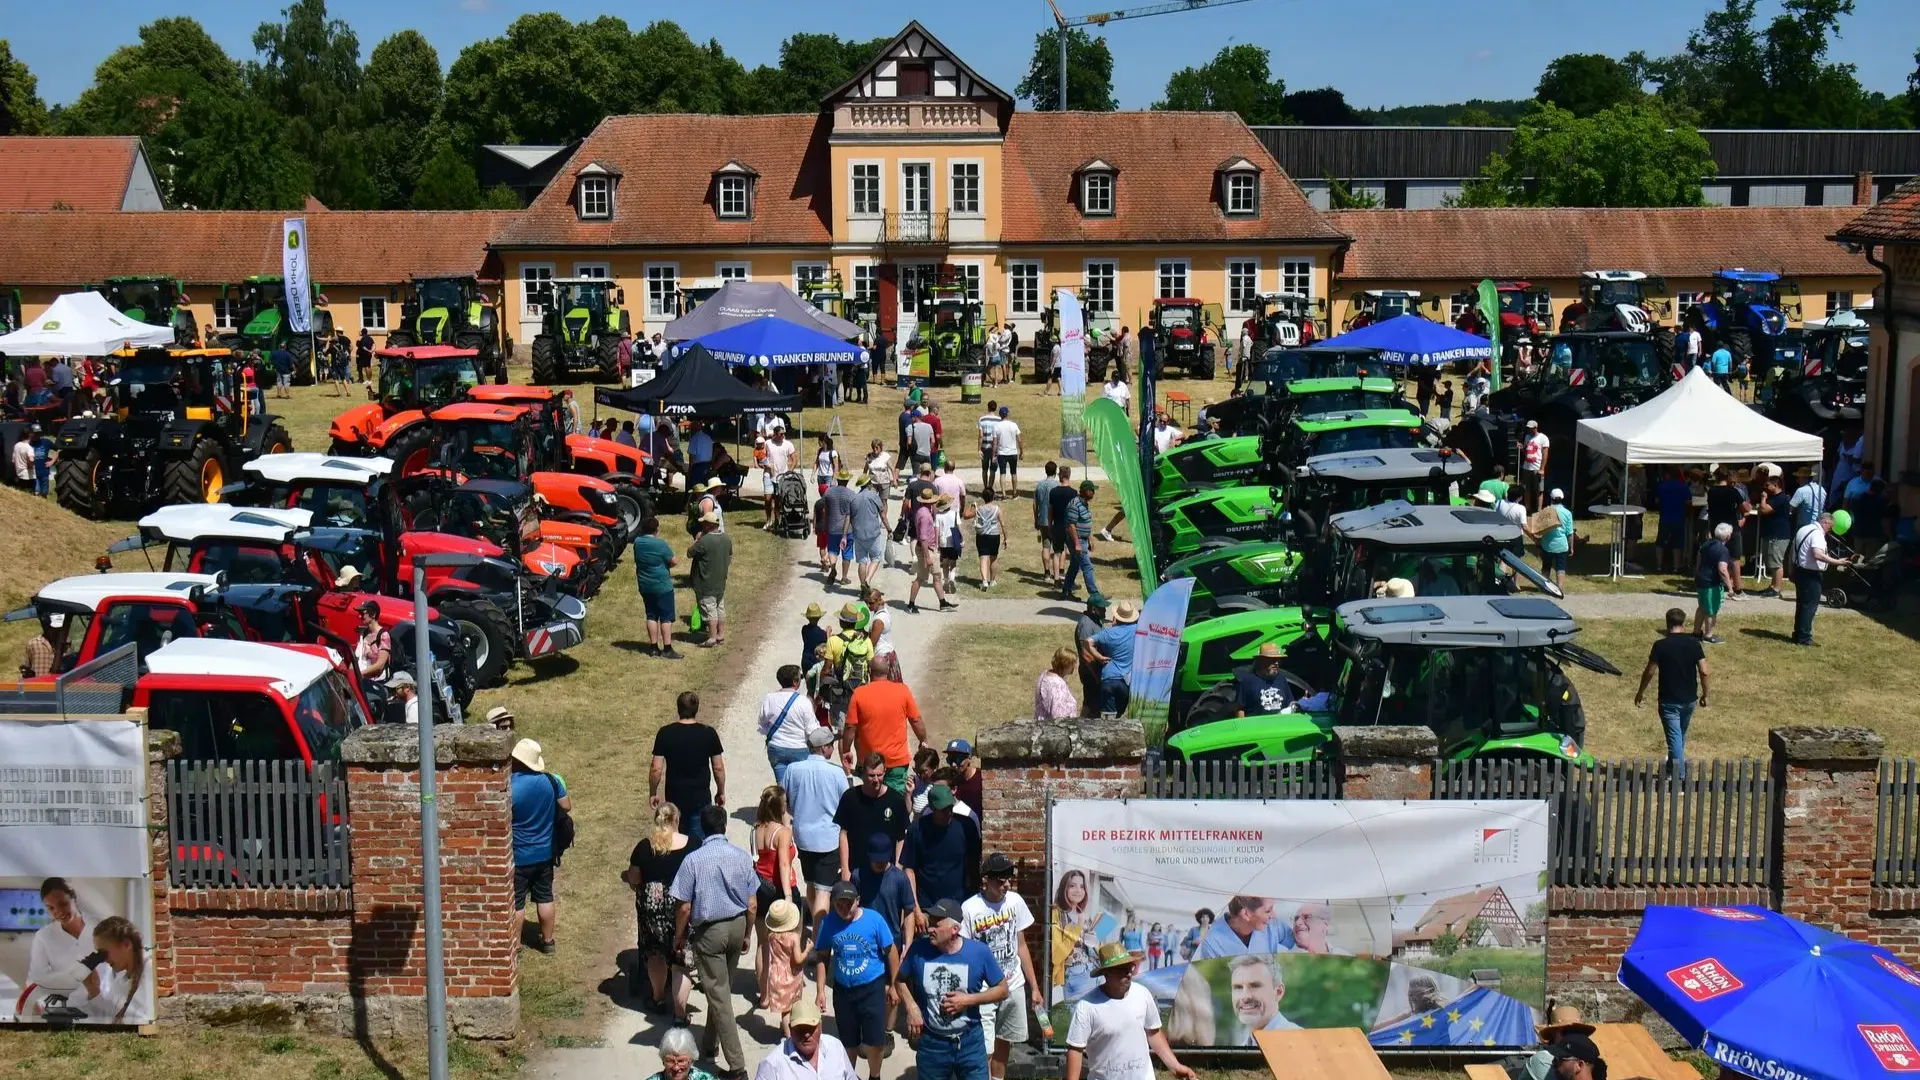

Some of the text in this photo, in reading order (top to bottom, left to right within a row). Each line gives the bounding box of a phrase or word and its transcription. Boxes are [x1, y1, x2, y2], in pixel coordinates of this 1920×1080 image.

[714, 351, 745, 362] BRUNNEN
[773, 352, 854, 364] FRANKEN BRUNNEN
[1432, 349, 1465, 362] FRANKEN
[664, 405, 697, 414] STIGA
[1082, 830, 1263, 841] DER BEZIRK MITTELFRANKEN
[1236, 845, 1265, 853] KULTUR
[1155, 856, 1265, 865] NATUR UND UMWELT EUROPA
[1688, 967, 1720, 993] SPRUDEL
[1698, 962, 1732, 989] RHÖN
[1864, 1029, 1906, 1043] RHÖN
[1874, 1044, 1913, 1052] SPRUDEL
